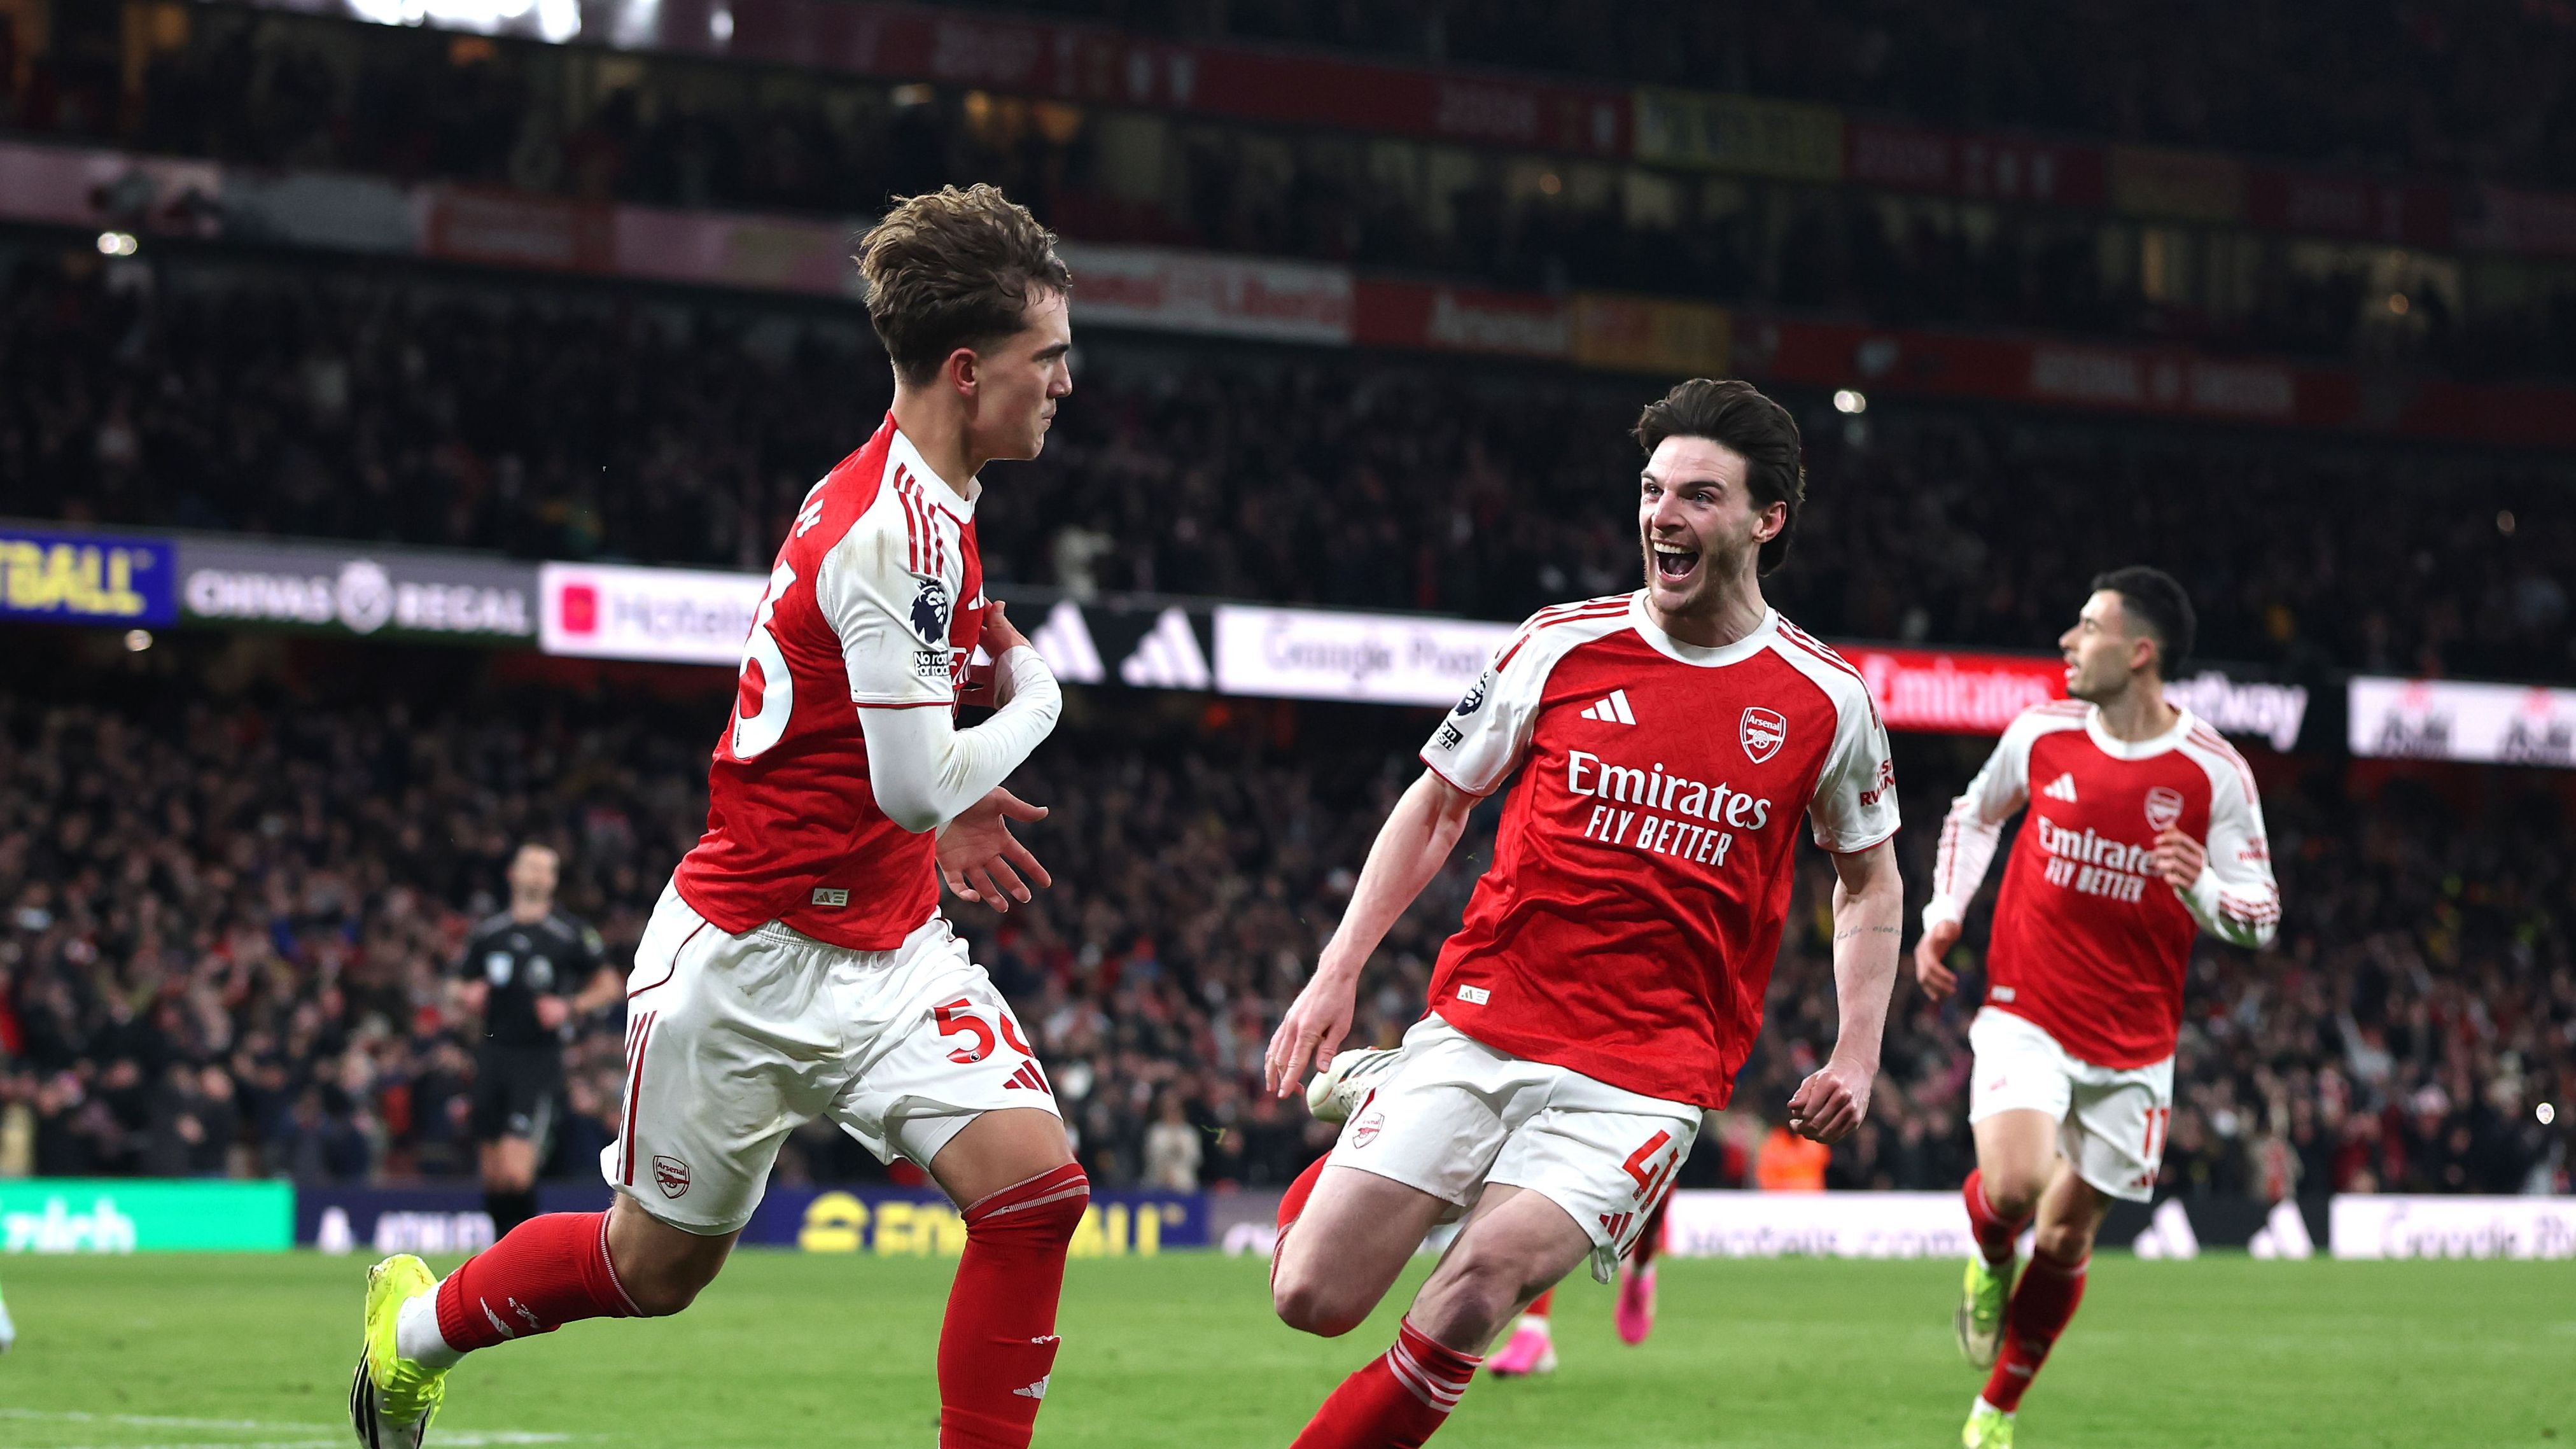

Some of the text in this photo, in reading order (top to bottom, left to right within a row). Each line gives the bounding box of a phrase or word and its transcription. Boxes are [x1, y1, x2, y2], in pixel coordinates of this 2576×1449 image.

[396, 580, 531, 635] REGAL
[1747, 714, 1781, 732] Arsenal
[1568, 749, 1772, 830] Emirates
[1584, 804, 1733, 867] FLY BETTER
[2038, 814, 2161, 878] Emirate
[2076, 864, 2146, 904] BETTER
[657, 1161, 685, 1176] Arsenal
[1621, 1129, 1679, 1214] 41
